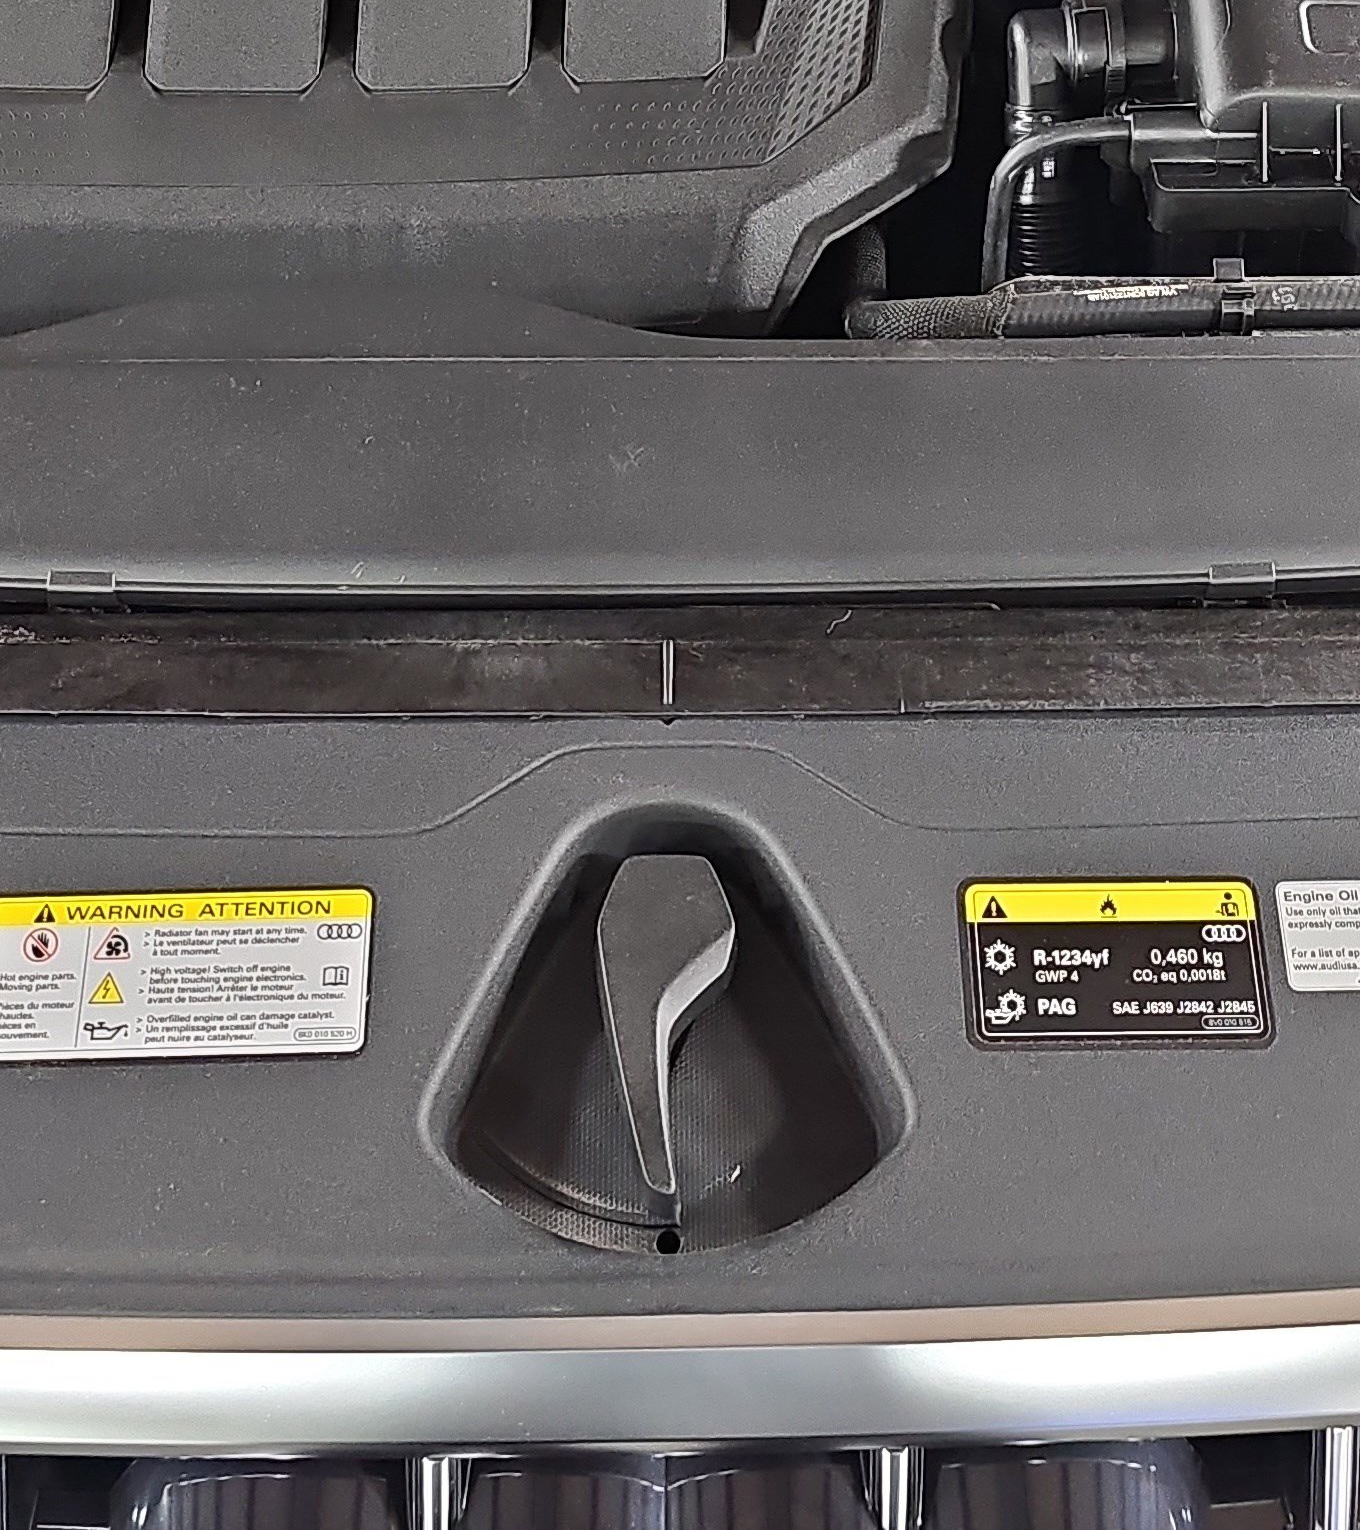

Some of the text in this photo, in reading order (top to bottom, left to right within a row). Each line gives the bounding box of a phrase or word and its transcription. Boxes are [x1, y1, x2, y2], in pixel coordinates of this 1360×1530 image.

[1284, 890, 1358, 903] Engine Oil
[66, 900, 332, 920] WARNING ATTENTION
[1286, 907, 1304, 916] Use
[1306, 907, 1326, 918] only
[1330, 906, 1340, 916] oil
[1288, 920, 1332, 930] expressly
[154, 926, 308, 938] Radiator fan may start at any time.
[154, 939, 164, 947] Le
[166, 938, 214, 946] ventilateur
[216, 938, 237, 947] peut
[251, 936, 300, 944] déclencher
[160, 948, 178, 956] tout
[180, 948, 220, 956] moment.
[1033, 948, 1224, 968] R-1234yf 0,460 kg
[1292, 948, 1307, 958] For
[1310, 950, 1316, 958] a
[1318, 948, 1332, 957] list
[1336, 948, 1346, 957] of
[151, 964, 290, 976] High voltage! Switch off engine
[1036, 970, 1080, 982] GWP 4
[0, 973, 76, 984] Hot engine parts.
[149, 974, 306, 986] before touching engine electronics.
[1160, 972, 1177, 984] eq
[1180, 970, 1226, 983] 0,0018t
[34, 983, 60, 992] parts.
[148, 984, 294, 994] Haute tension! Arrêter le moteur
[147, 996, 172, 1004] avant
[175, 995, 186, 1003] de
[188, 994, 223, 1003] toucher
[297, 992, 309, 1000] du
[312, 992, 346, 1000] moteur.
[27, 1002, 40, 1010] du
[42, 1002, 75, 1010] moteur
[1037, 998, 1076, 1015] PAG
[1112, 1000, 1256, 1015] SAE J639 J2842 J2845
[147, 1014, 192, 1023] Overfilled
[194, 1014, 224, 1024] engine
[226, 1013, 238, 1021] oil
[259, 1012, 296, 1022] damage
[298, 1010, 334, 1020] catalyst.
[24, 1022, 36, 1030] en
[146, 1025, 158, 1033] Un
[162, 1024, 216, 1034] remplissage
[220, 1022, 256, 1031] excessif
[145, 1035, 165, 1044] peut
[168, 1034, 192, 1042] nuire
[208, 1033, 256, 1042] catalyseur.
